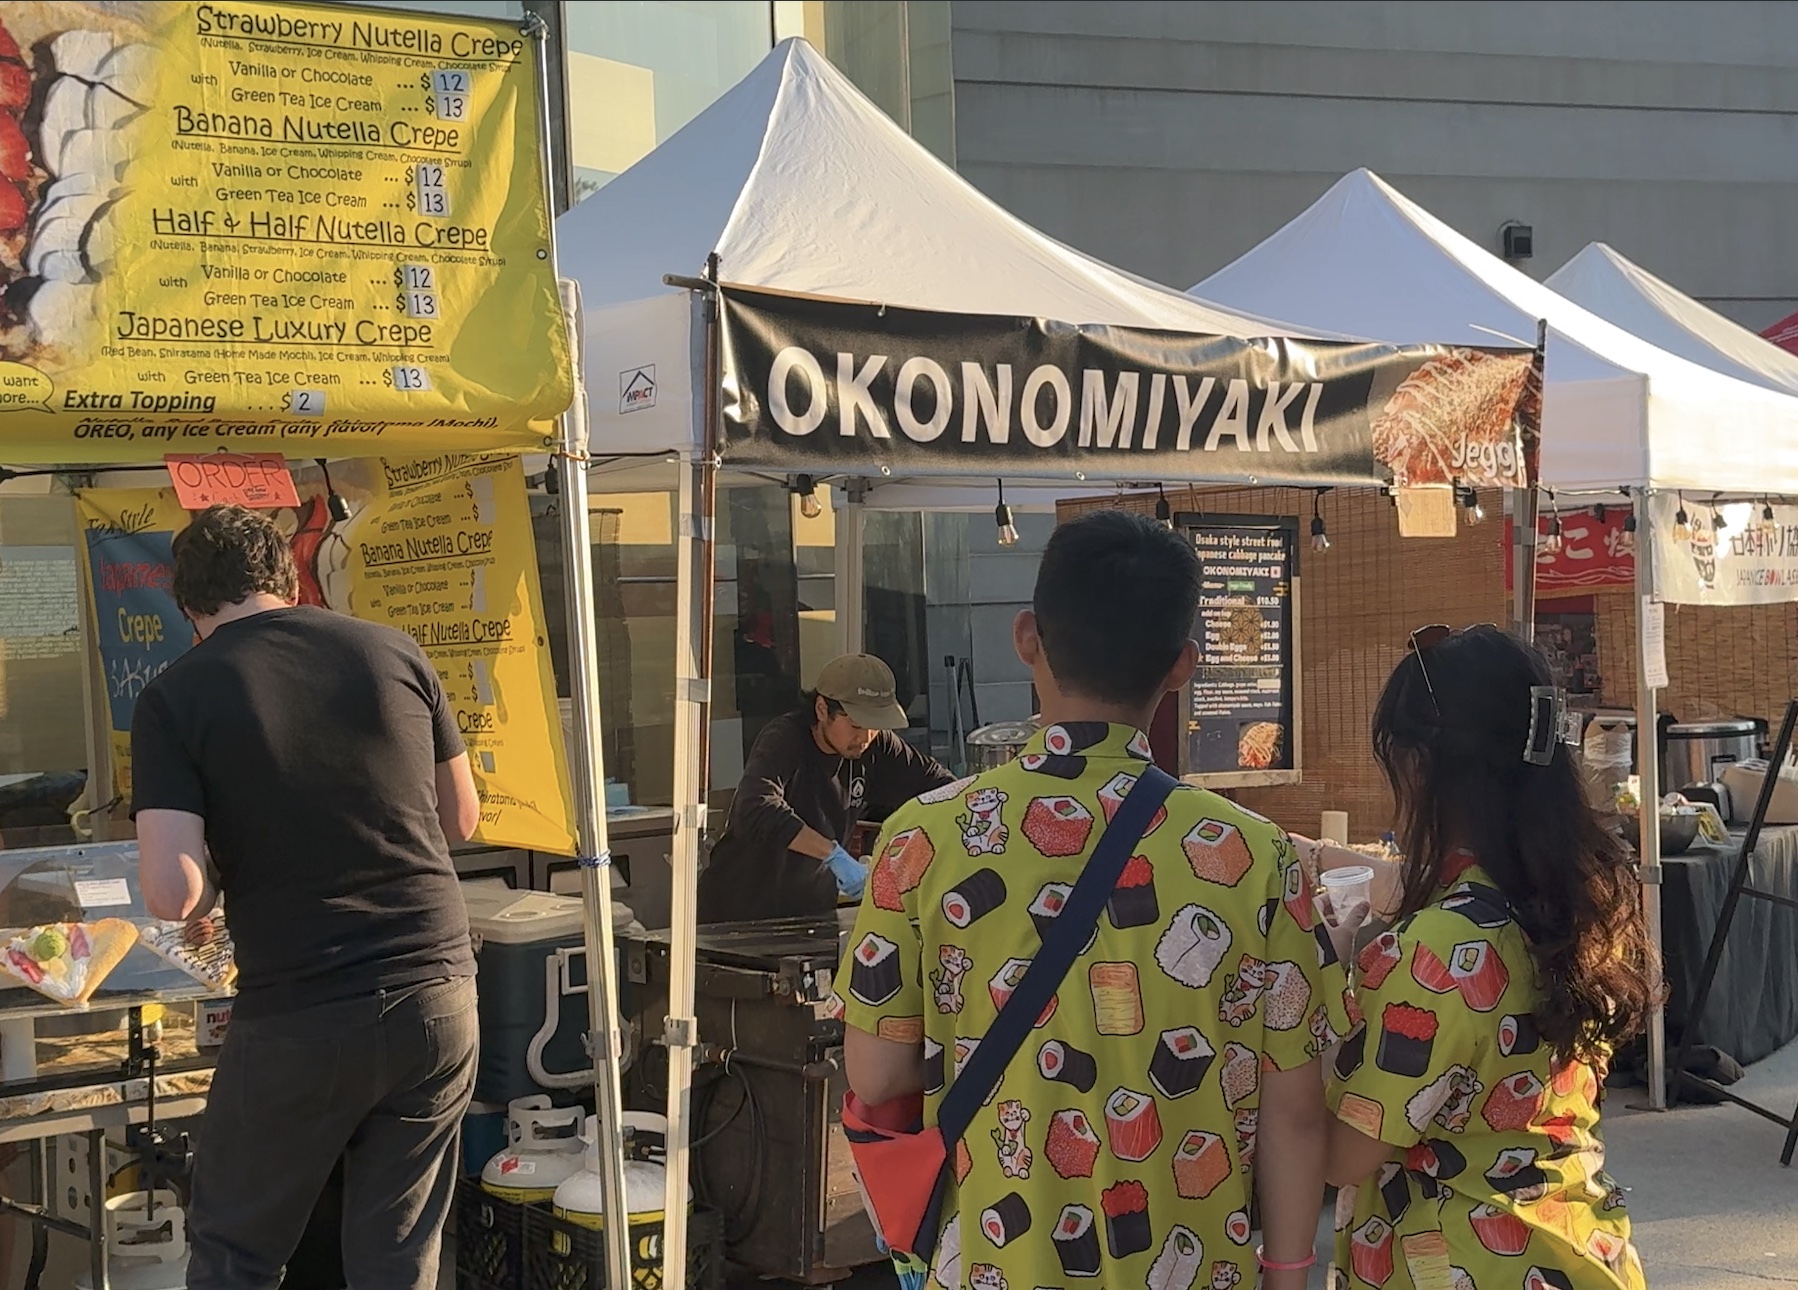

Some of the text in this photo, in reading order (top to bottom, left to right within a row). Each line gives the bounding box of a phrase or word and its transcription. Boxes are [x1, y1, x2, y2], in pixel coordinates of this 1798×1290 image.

[196, 5, 523, 58] Strawberry Nutella Crepe
[307, 48, 322, 58] Ice
[360, 52, 402, 66] Whipping
[438, 60, 487, 71] Chocolate
[191, 73, 218, 86] with
[228, 61, 277, 78] Vanilla
[281, 67, 297, 79] or
[301, 67, 373, 87] Chocolate
[231, 87, 275, 103] Green
[279, 92, 305, 107] Tea
[309, 94, 332, 109] Ice
[336, 97, 382, 112] Cream
[173, 105, 459, 149] Banana Nutella Crepe
[261, 146, 277, 157] Ice
[317, 148, 363, 160] Whipping
[400, 153, 442, 166] Chocolate
[171, 175, 198, 187] with
[211, 162, 262, 178] Vanilla
[266, 166, 283, 177] or
[287, 165, 363, 181] Chocolate
[215, 187, 262, 201] Green
[265, 189, 294, 204] Tea
[299, 190, 321, 205] Ice
[326, 191, 367, 208] Cream
[153, 208, 487, 248] Half & Half Nutella Crepe
[299, 247, 314, 257] Ice
[352, 250, 394, 262] Whipping
[431, 253, 477, 265] Chocolate
[159, 276, 188, 288] with
[200, 264, 250, 280] Vanilla
[254, 269, 269, 280] or
[273, 268, 347, 284] Chocolate
[203, 291, 246, 306] Green
[250, 293, 278, 308] Tea
[283, 294, 306, 309] Ice
[310, 295, 355, 310] Cream
[117, 311, 432, 346] Japanese Luxury Crepe
[248, 349, 277, 360] Made
[318, 351, 334, 361] Ice
[372, 352, 415, 364] Whipping
[3, 375, 39, 387] want
[137, 370, 166, 383] with
[184, 370, 230, 384] Green
[233, 371, 262, 386] Tea
[265, 371, 290, 386] Ice
[294, 371, 341, 386] Cream
[63, 389, 123, 409] Extra
[130, 390, 216, 413] Topping
[767, 346, 1323, 453] OKONOMIYAKI
[73, 423, 136, 441] OREO,
[141, 424, 178, 442] any
[182, 422, 209, 437] Ice
[215, 422, 277, 438] Cream
[280, 422, 322, 438] (any
[177, 459, 285, 489] ORDER
[384, 455, 443, 487] Strawberry
[360, 530, 493, 565] Banana Nutella Crepe
[1195, 533, 1219, 546] Osaka
[1220, 534, 1240, 549] style
[1241, 535, 1266, 547] street
[1228, 548, 1257, 563] cabbage
[1258, 549, 1286, 564] pancake
[1203, 565, 1270, 577] OKONOMIYAKI
[1199, 595, 1246, 606] Traditional
[117, 607, 164, 650] Crepe
[431, 621, 470, 645] Nutella
[472, 618, 511, 642] Crepe
[457, 709, 493, 732] Crepe
[206, 1009, 233, 1024] nut
